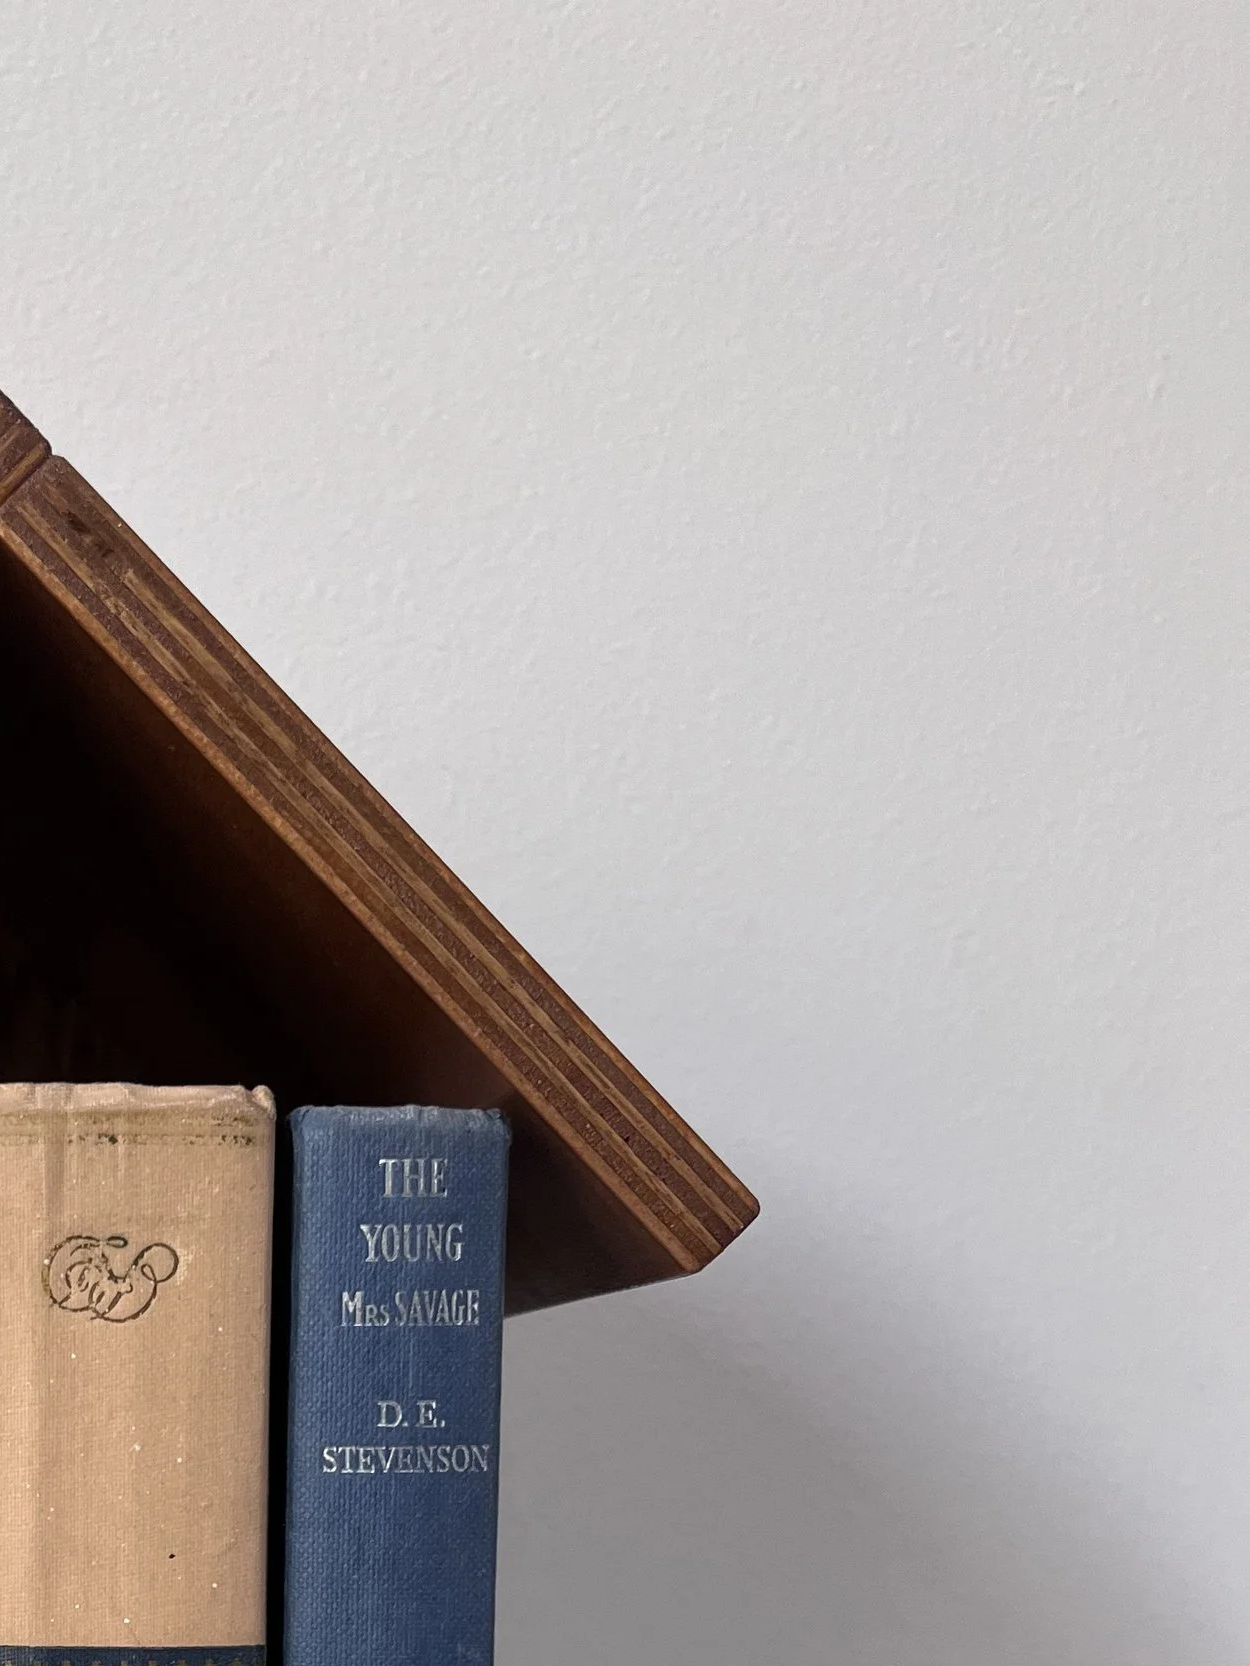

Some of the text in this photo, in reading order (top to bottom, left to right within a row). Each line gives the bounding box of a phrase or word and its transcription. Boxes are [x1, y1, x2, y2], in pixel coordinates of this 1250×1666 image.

[379, 1158, 448, 1199] THE
[360, 1224, 463, 1263] YOUNG
[395, 1289, 480, 1327] SAVAGE
[377, 1400, 446, 1428] D. E.
[322, 1444, 490, 1474] STEVENSON
